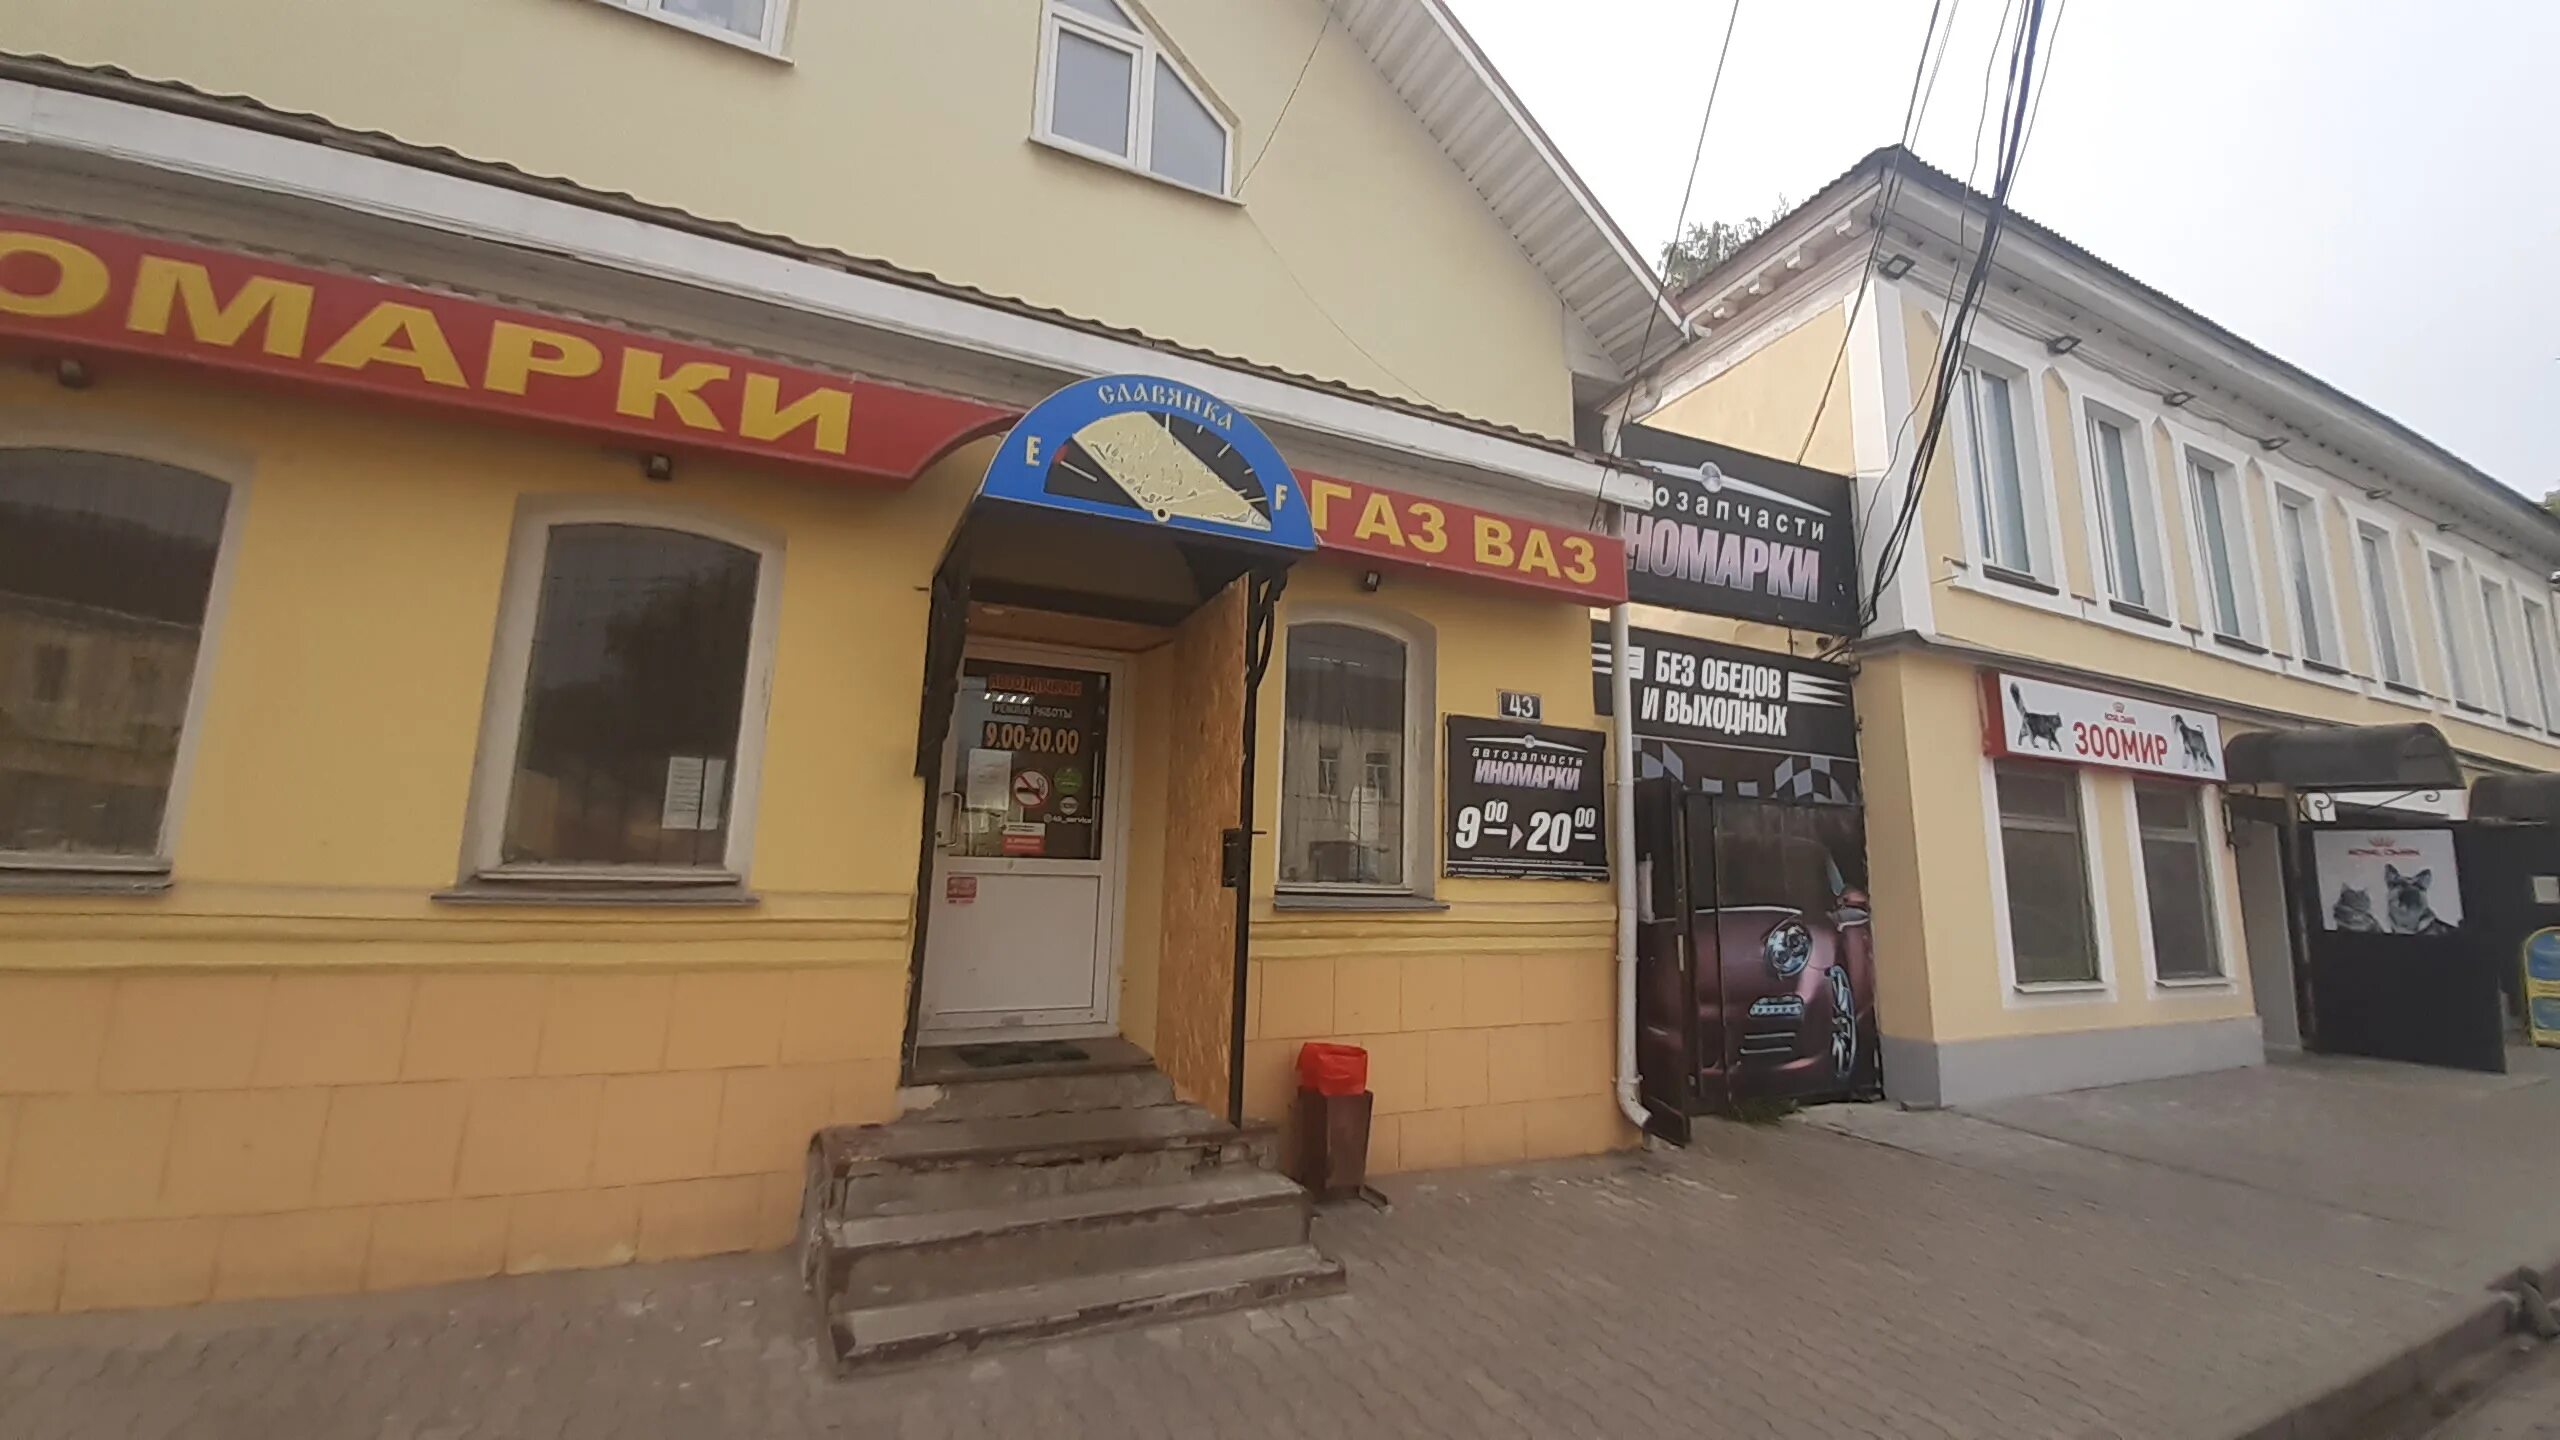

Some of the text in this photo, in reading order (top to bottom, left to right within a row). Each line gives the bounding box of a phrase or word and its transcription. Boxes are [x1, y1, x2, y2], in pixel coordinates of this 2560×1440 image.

[1098, 382, 1233, 431] СЛАВЯНКА
[1311, 479, 1597, 584] ГАЗ ВАЗ
[1655, 486, 1825, 541] озапчасти
[1655, 650, 1782, 700] БЕЗ ОБЕДОВ
[1508, 694, 1535, 718] 43
[1641, 687, 1788, 738] И ВЫХОДНЫХ
[1472, 747, 1583, 767] автозапчасти
[2072, 721, 2168, 766] ЗООМИР
[1474, 758, 1581, 791] ИНОМАРКИ
